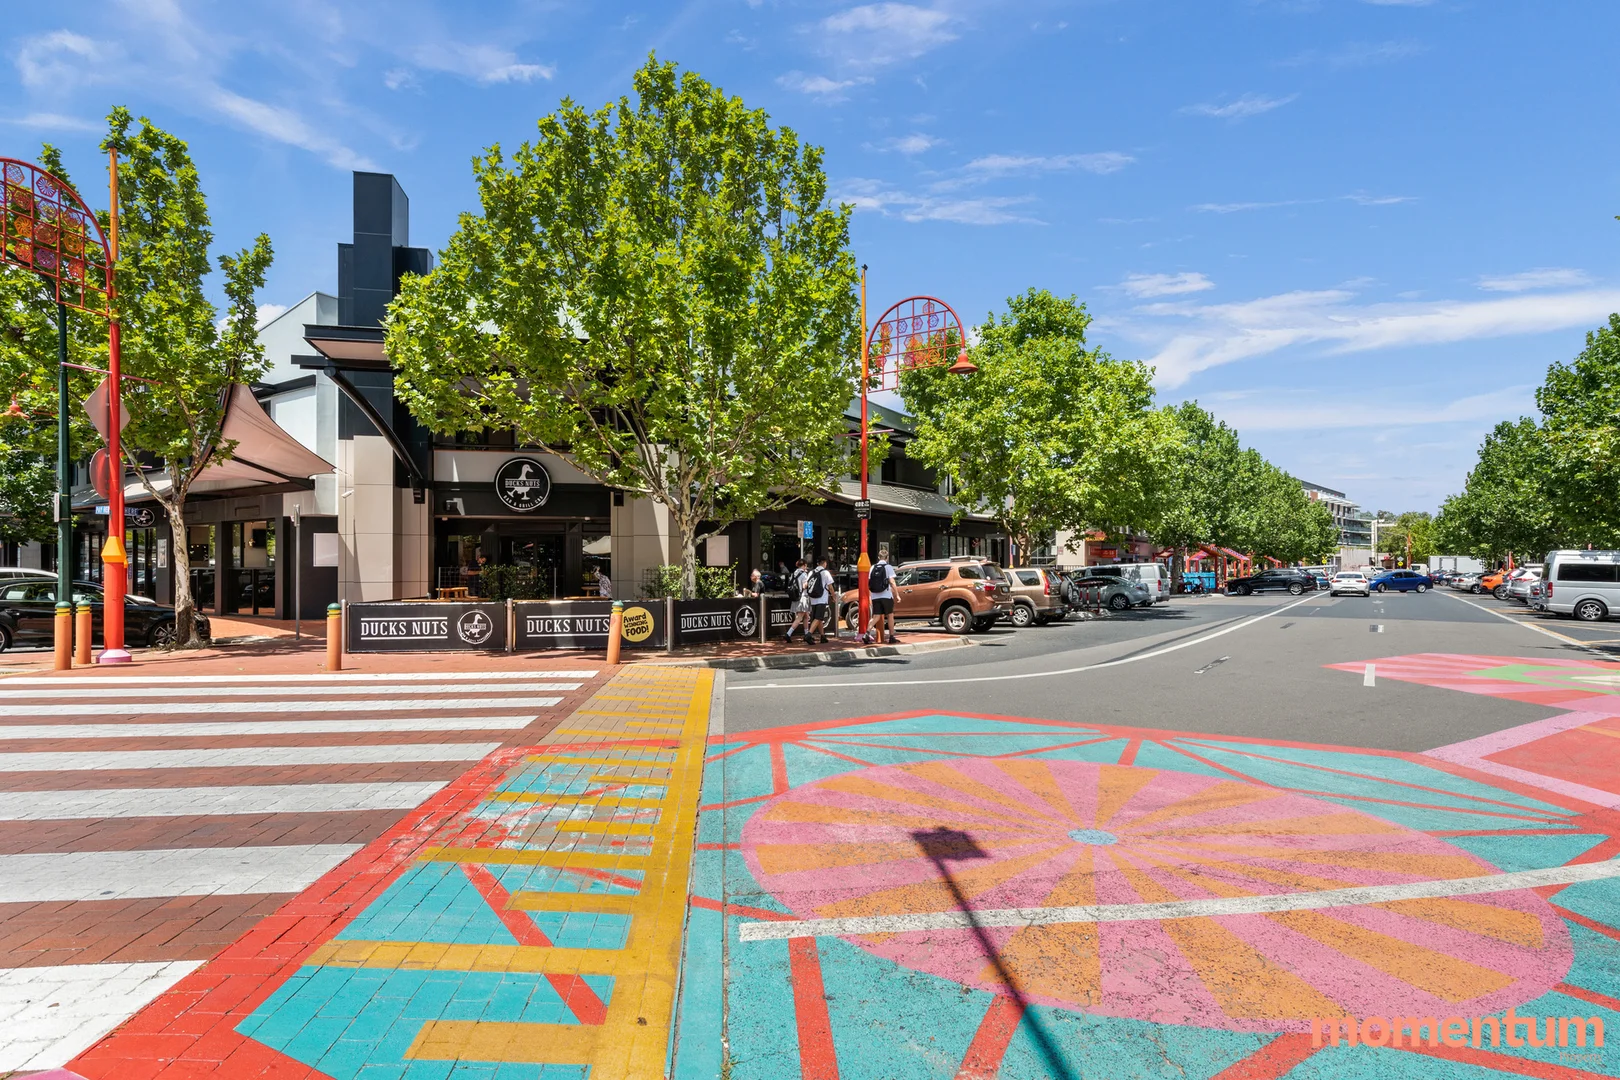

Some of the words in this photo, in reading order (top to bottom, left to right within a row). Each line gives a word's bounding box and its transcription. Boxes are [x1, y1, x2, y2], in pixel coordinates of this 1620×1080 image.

[623, 612, 647, 624] Award
[681, 616, 709, 629] DUCKS
[711, 614, 732, 627] NUTS
[771, 612, 793, 623] DUCKS
[361, 621, 407, 636] DUCKS
[412, 620, 448, 635] NUTS
[527, 619, 571, 633] DUCKS
[575, 618, 610, 632] NUTS
[623, 620, 648, 628] WINNING
[625, 625, 650, 637] FOOD!
